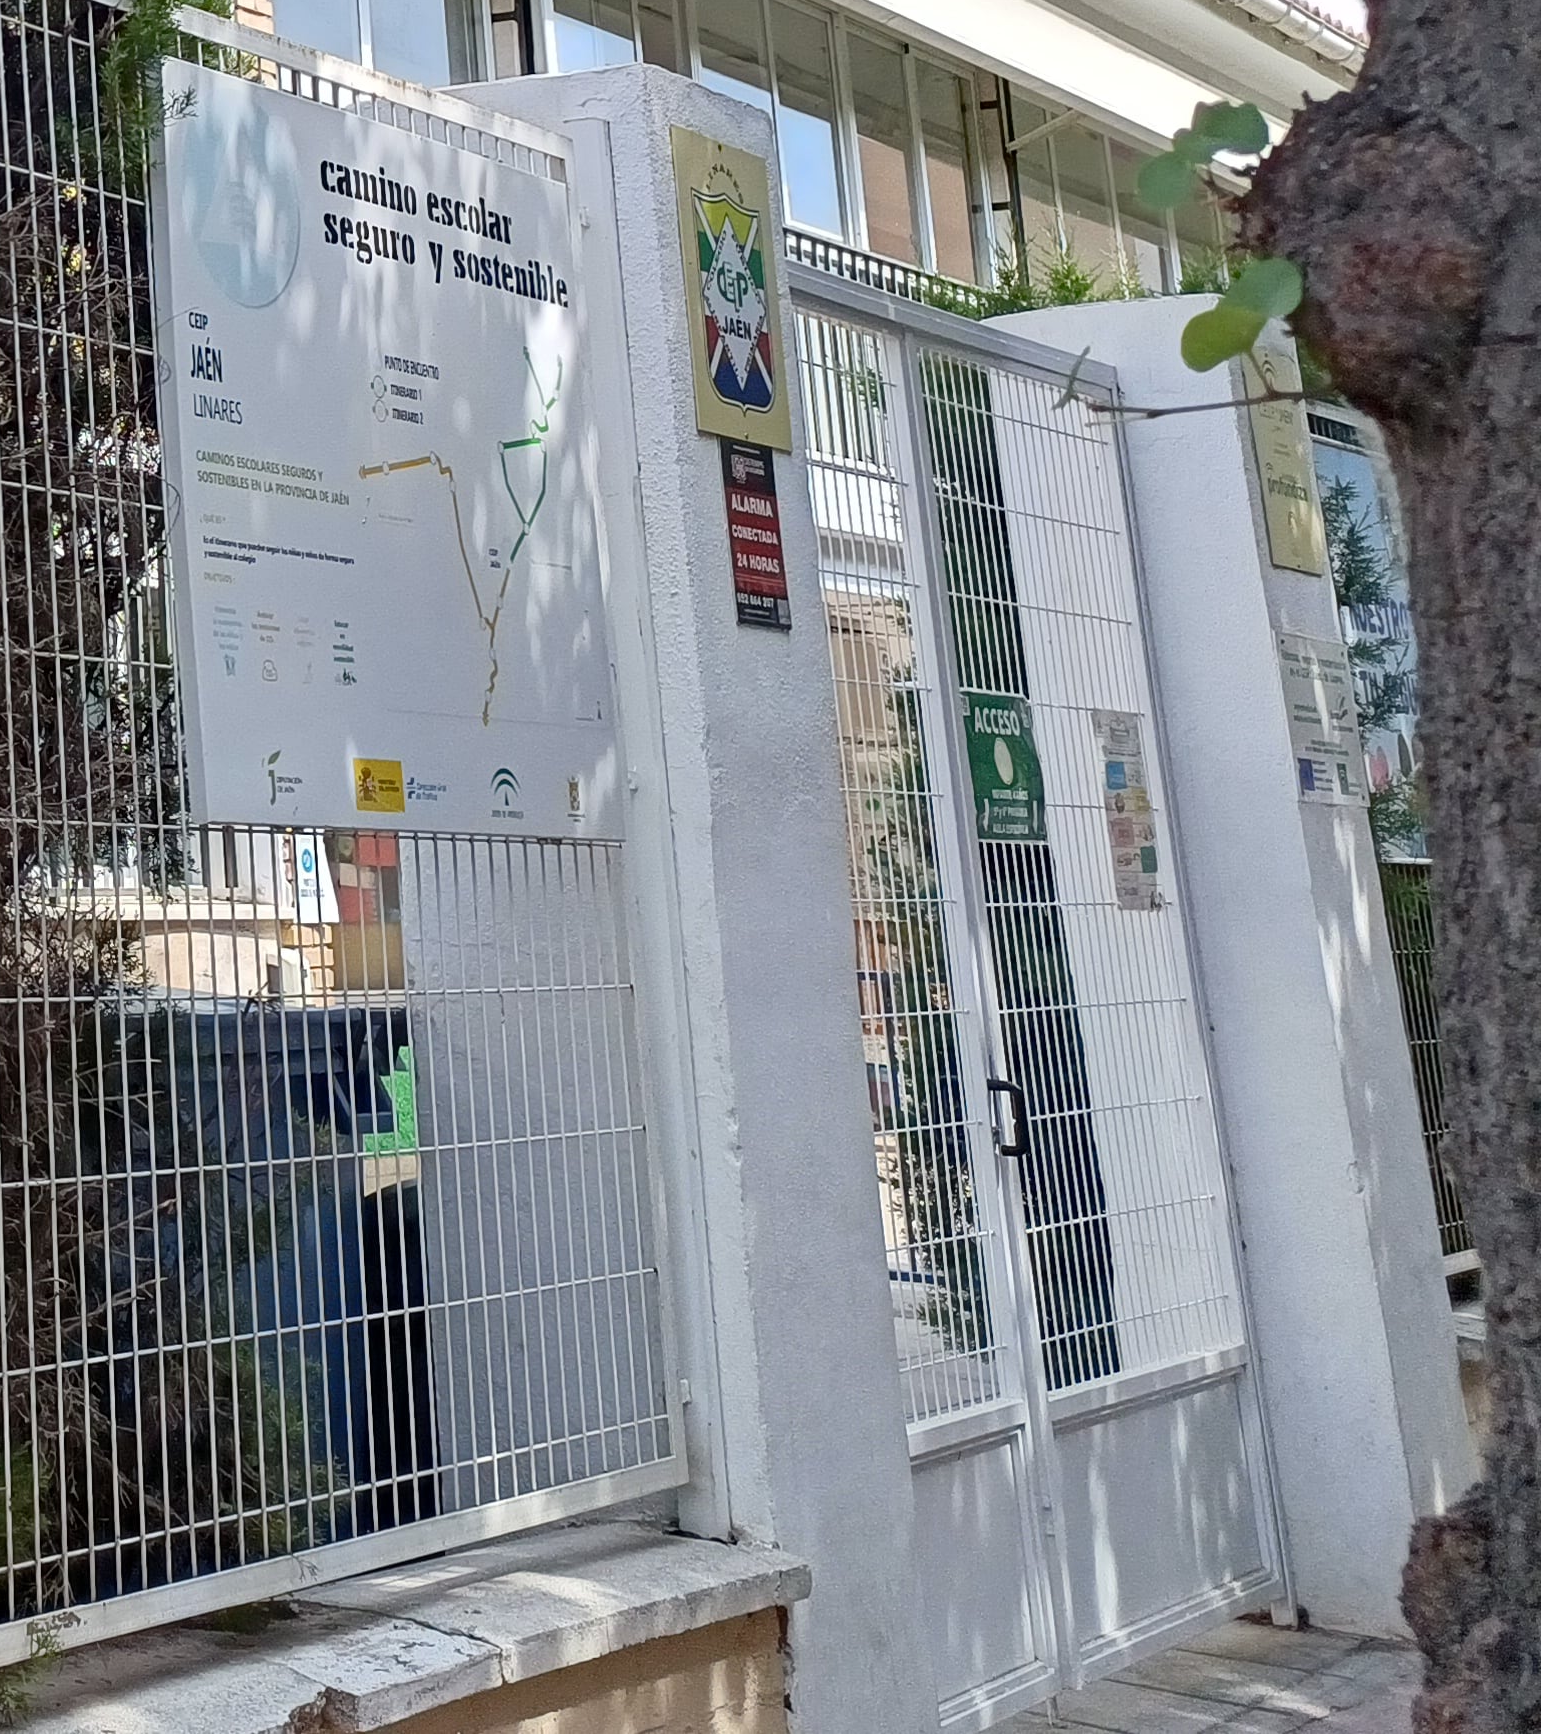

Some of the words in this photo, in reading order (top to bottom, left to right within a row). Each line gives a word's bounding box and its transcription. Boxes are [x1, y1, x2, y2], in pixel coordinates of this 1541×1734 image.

[704, 162, 745, 205] LINARES
[320, 160, 417, 216] camino
[427, 192, 512, 245] escolar
[323, 213, 415, 265] seguro
[429, 242, 443, 284] y
[453, 248, 569, 308] sostenible
[189, 312, 208, 331] CEIP
[722, 313, 753, 341] JAÉN
[191, 337, 223, 383] JAÉN
[193, 393, 243, 425] LINARES
[196, 449, 235, 467] CAMINOS
[236, 456, 280, 475] ESCOLARES
[281, 464, 317, 482] SEGUROS
[317, 470, 323, 483] Y
[197, 470, 249, 490] SOSTENIBLES
[251, 479, 262, 492] EN
[263, 482, 274, 494] LA
[275, 483, 317, 501] PROVINCIA
[319, 490, 329, 503] DE
[330, 490, 349, 506] JAÉN
[731, 493, 774, 518] ALARMA
[732, 524, 779, 545] CONECTADA
[736, 552, 748, 568] 24
[748, 554, 780, 574] HORAS
[975, 706, 1021, 737] ACCESO
